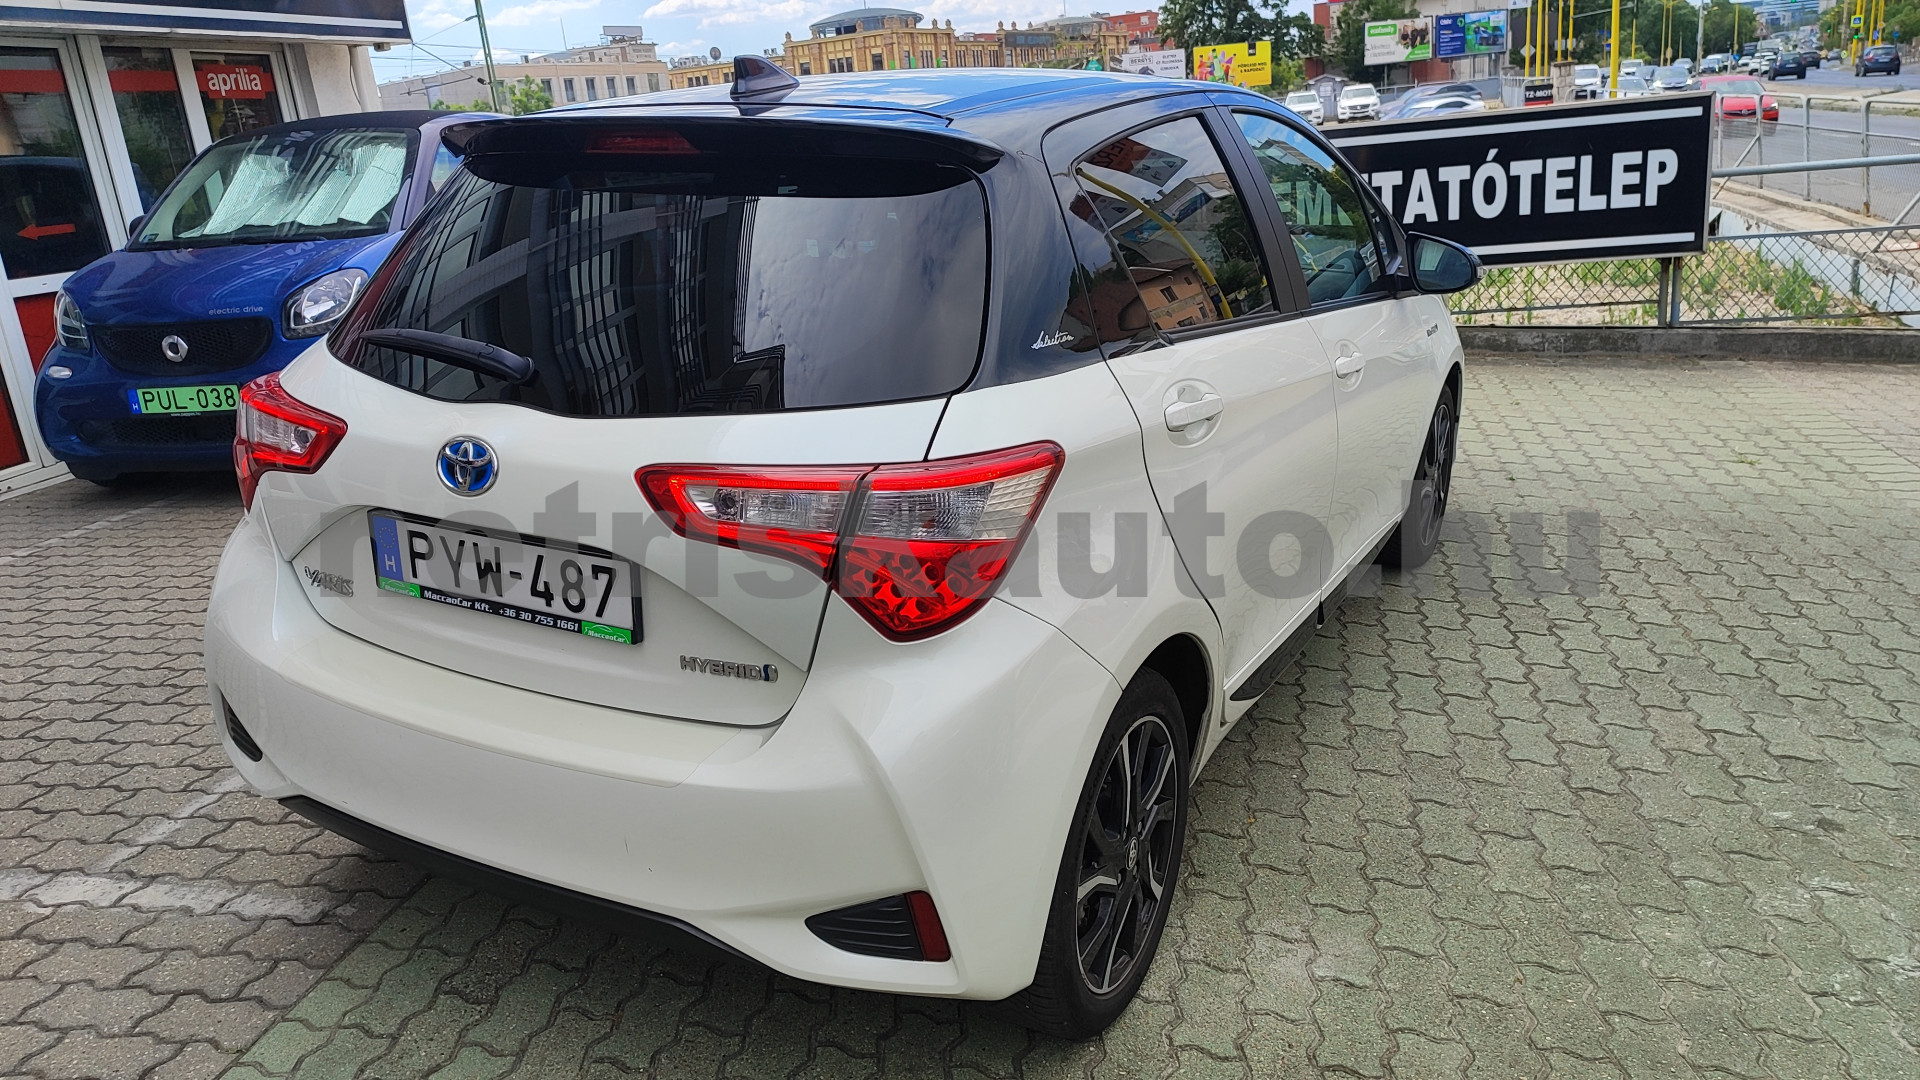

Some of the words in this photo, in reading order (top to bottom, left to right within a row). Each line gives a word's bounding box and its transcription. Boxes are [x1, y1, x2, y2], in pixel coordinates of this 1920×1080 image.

[207, 67, 262, 97] aprilia
[1525, 89, 1552, 98] TZ-MOT
[209, 307, 240, 316] electric
[243, 305, 263, 313] drive
[1031, 330, 1074, 350] Selection
[142, 387, 236, 411] PUL-038
[385, 554, 397, 573] H
[407, 528, 618, 618] PYW-487
[304, 565, 354, 597] YARIS
[424, 590, 473, 608] MaccaoCar
[475, 602, 493, 613] Kft.
[499, 607, 516, 618] +36
[519, 612, 532, 621] 30
[535, 614, 554, 626] 755
[557, 619, 579, 632] 1661
[587, 630, 626, 643] MaccaoCar
[680, 655, 762, 681] HYBRID
